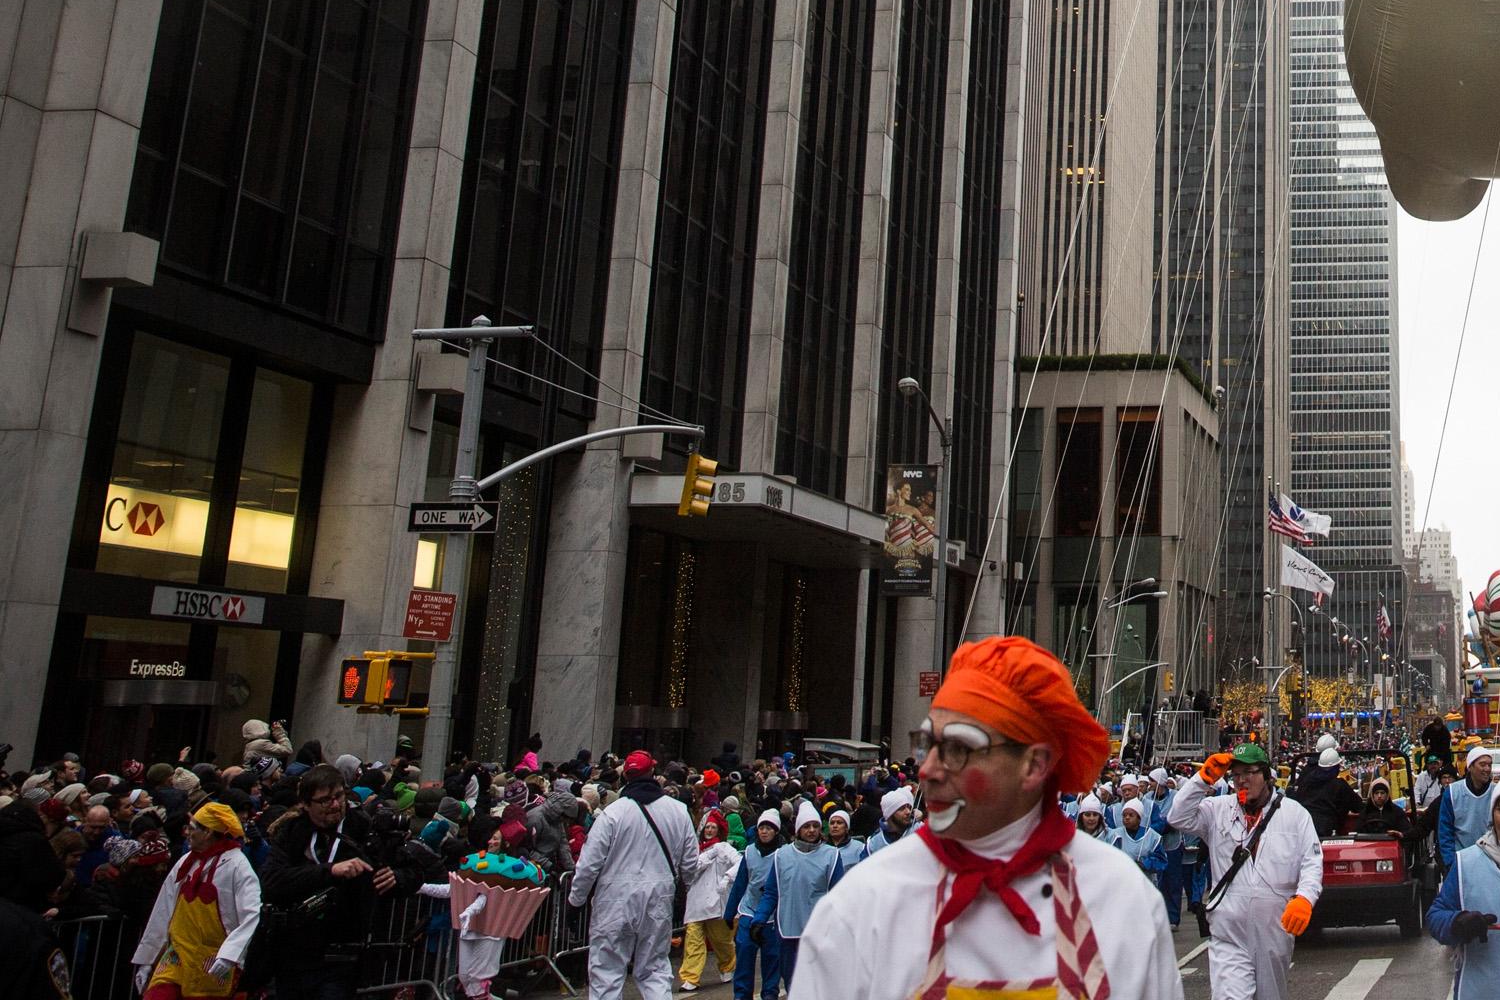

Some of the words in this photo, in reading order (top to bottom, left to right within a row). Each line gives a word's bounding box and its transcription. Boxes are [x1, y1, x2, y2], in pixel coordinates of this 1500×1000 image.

[902, 470, 923, 479] NYC
[711, 482, 746, 502] 85
[421, 511, 447, 524] ONE
[459, 511, 486, 524] WAY
[173, 591, 221, 618] HSBC
[424, 595, 453, 604] STANDING
